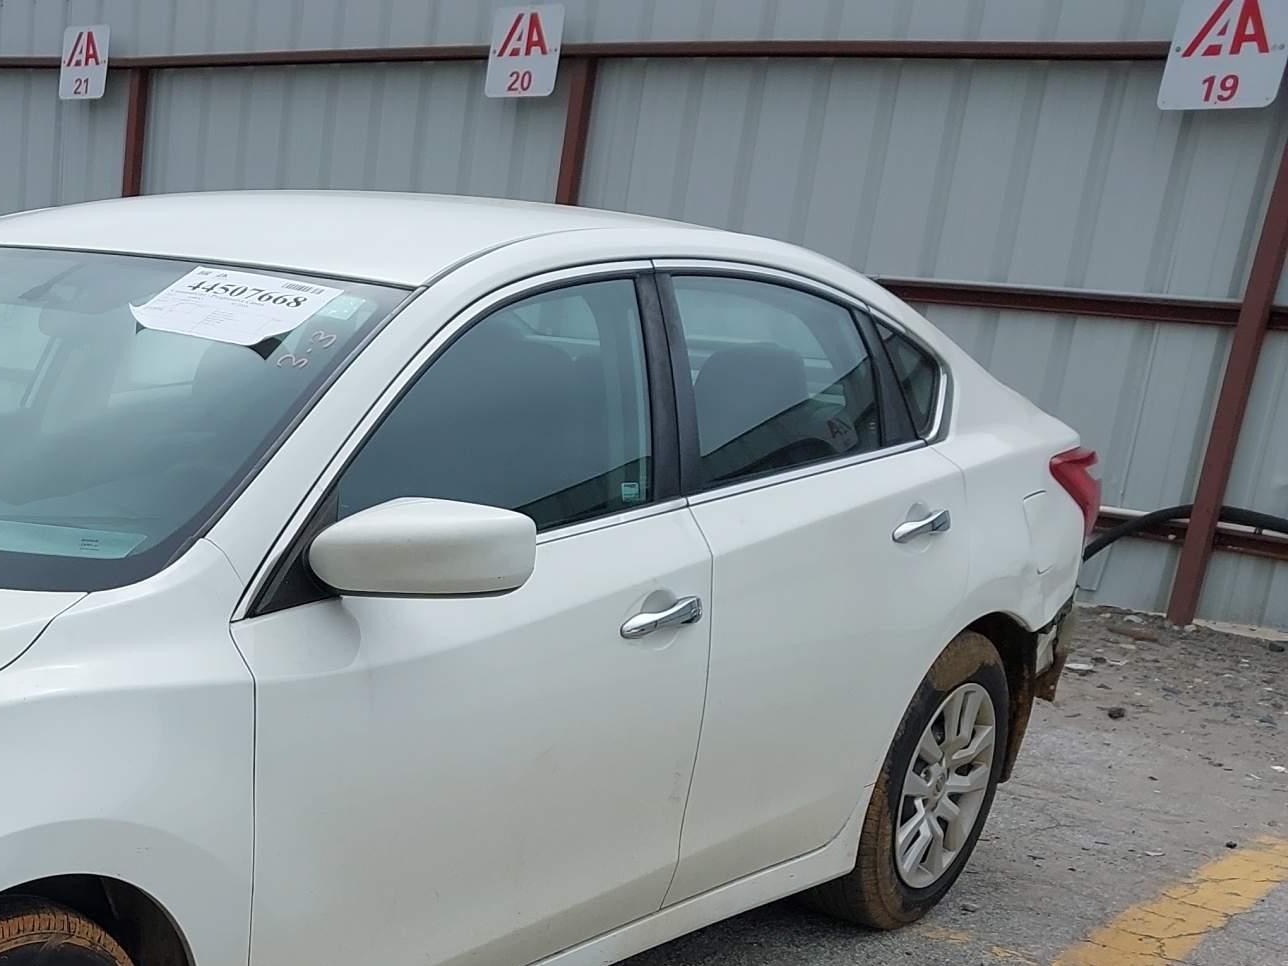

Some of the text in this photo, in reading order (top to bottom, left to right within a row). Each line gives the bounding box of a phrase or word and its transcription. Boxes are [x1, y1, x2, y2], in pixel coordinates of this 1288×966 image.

[73, 77, 89, 95] 21
[507, 70, 532, 92] 20
[1202, 74, 1240, 103] 19
[187, 280, 308, 309] 44507668
